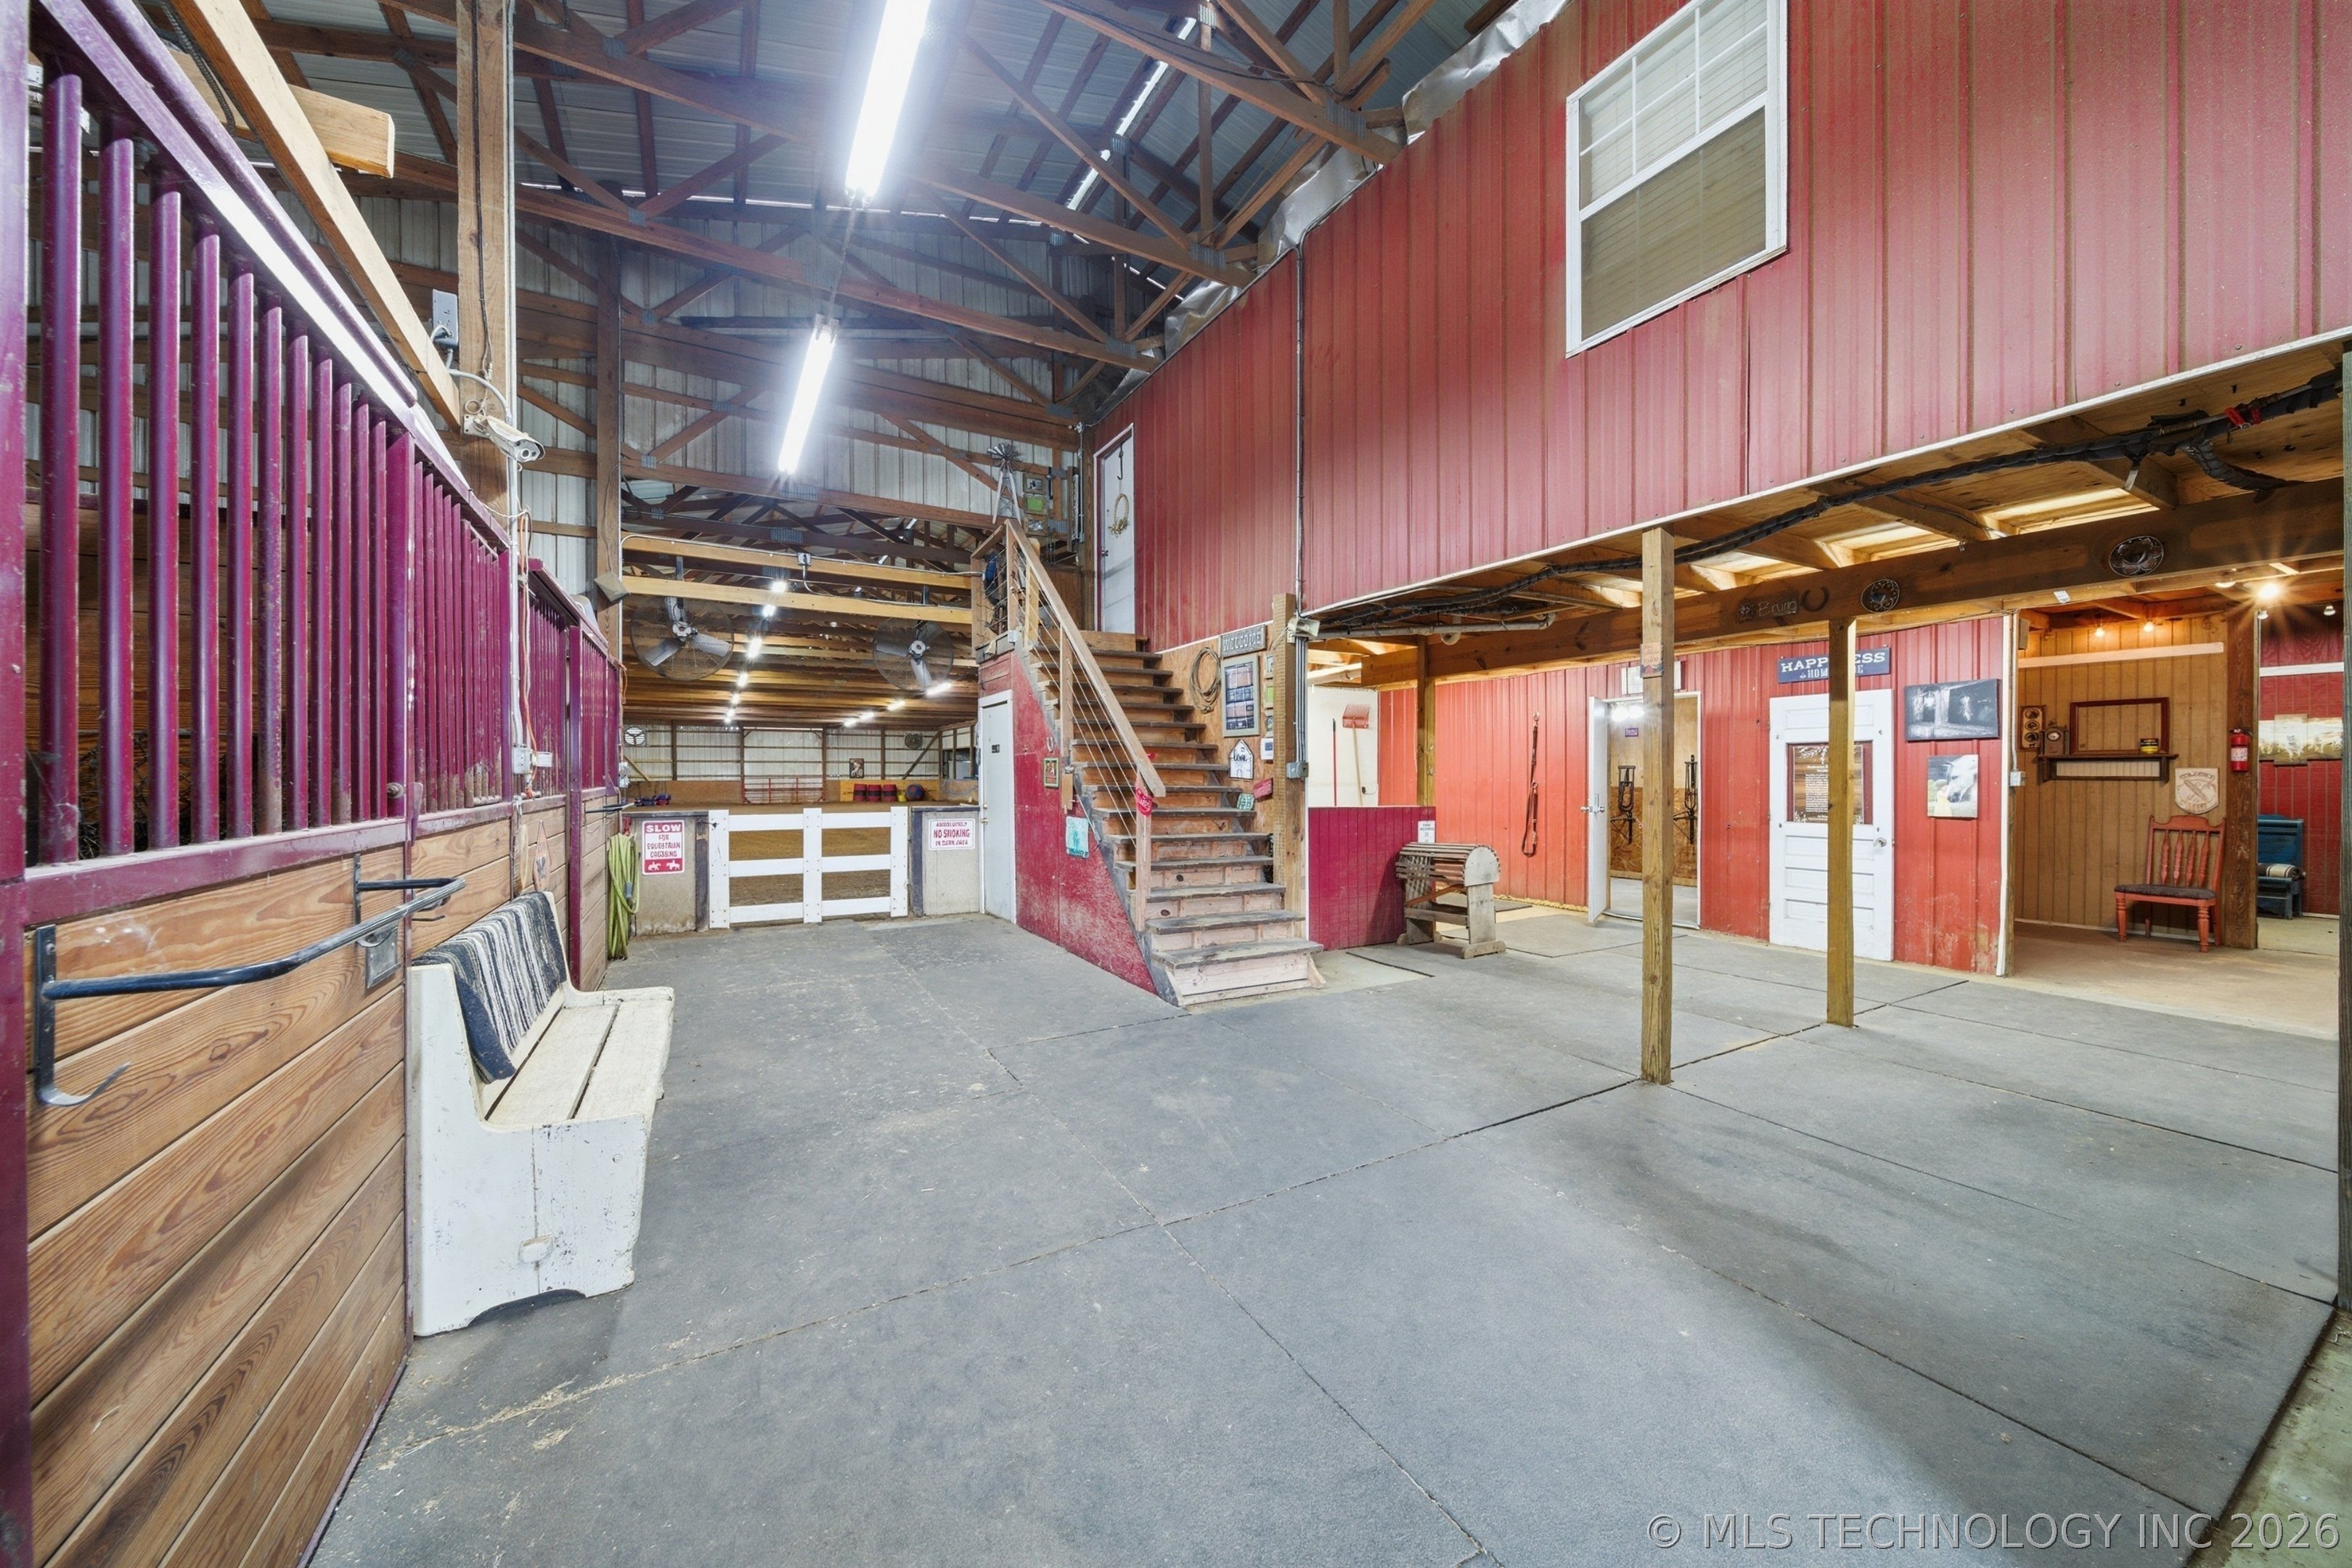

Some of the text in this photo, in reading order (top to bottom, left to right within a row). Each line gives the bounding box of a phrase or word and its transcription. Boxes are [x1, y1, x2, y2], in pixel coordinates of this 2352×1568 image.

[1222, 632, 1261, 651] WELCOME
[1781, 652, 1885, 672] HAPPESS
[646, 824, 681, 833] SLOW
[934, 828, 970, 838] NO SMOKING
